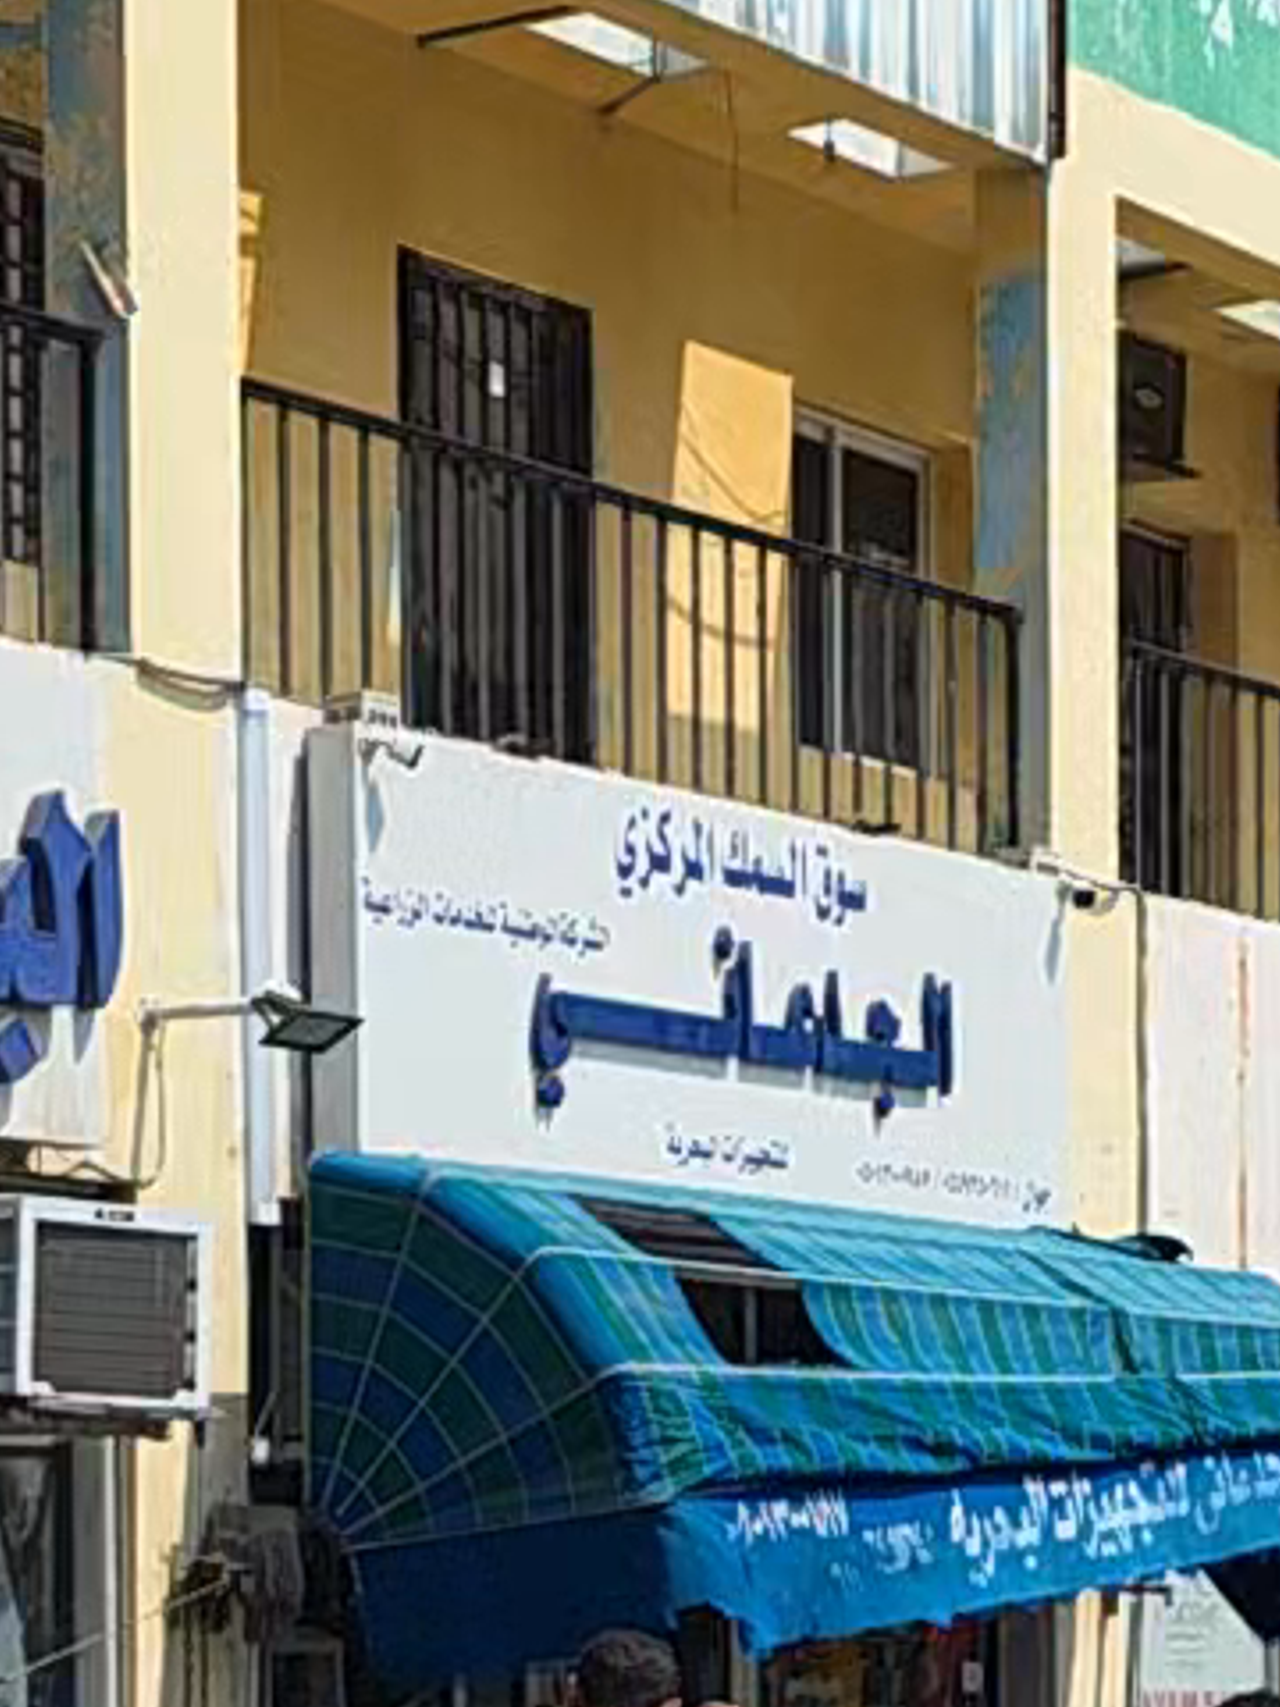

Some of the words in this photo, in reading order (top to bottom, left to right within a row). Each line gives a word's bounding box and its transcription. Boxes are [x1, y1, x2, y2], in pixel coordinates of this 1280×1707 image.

[617, 806, 714, 898] المركزي
[723, 829, 808, 899] السمك
[815, 844, 867, 926] سوق
